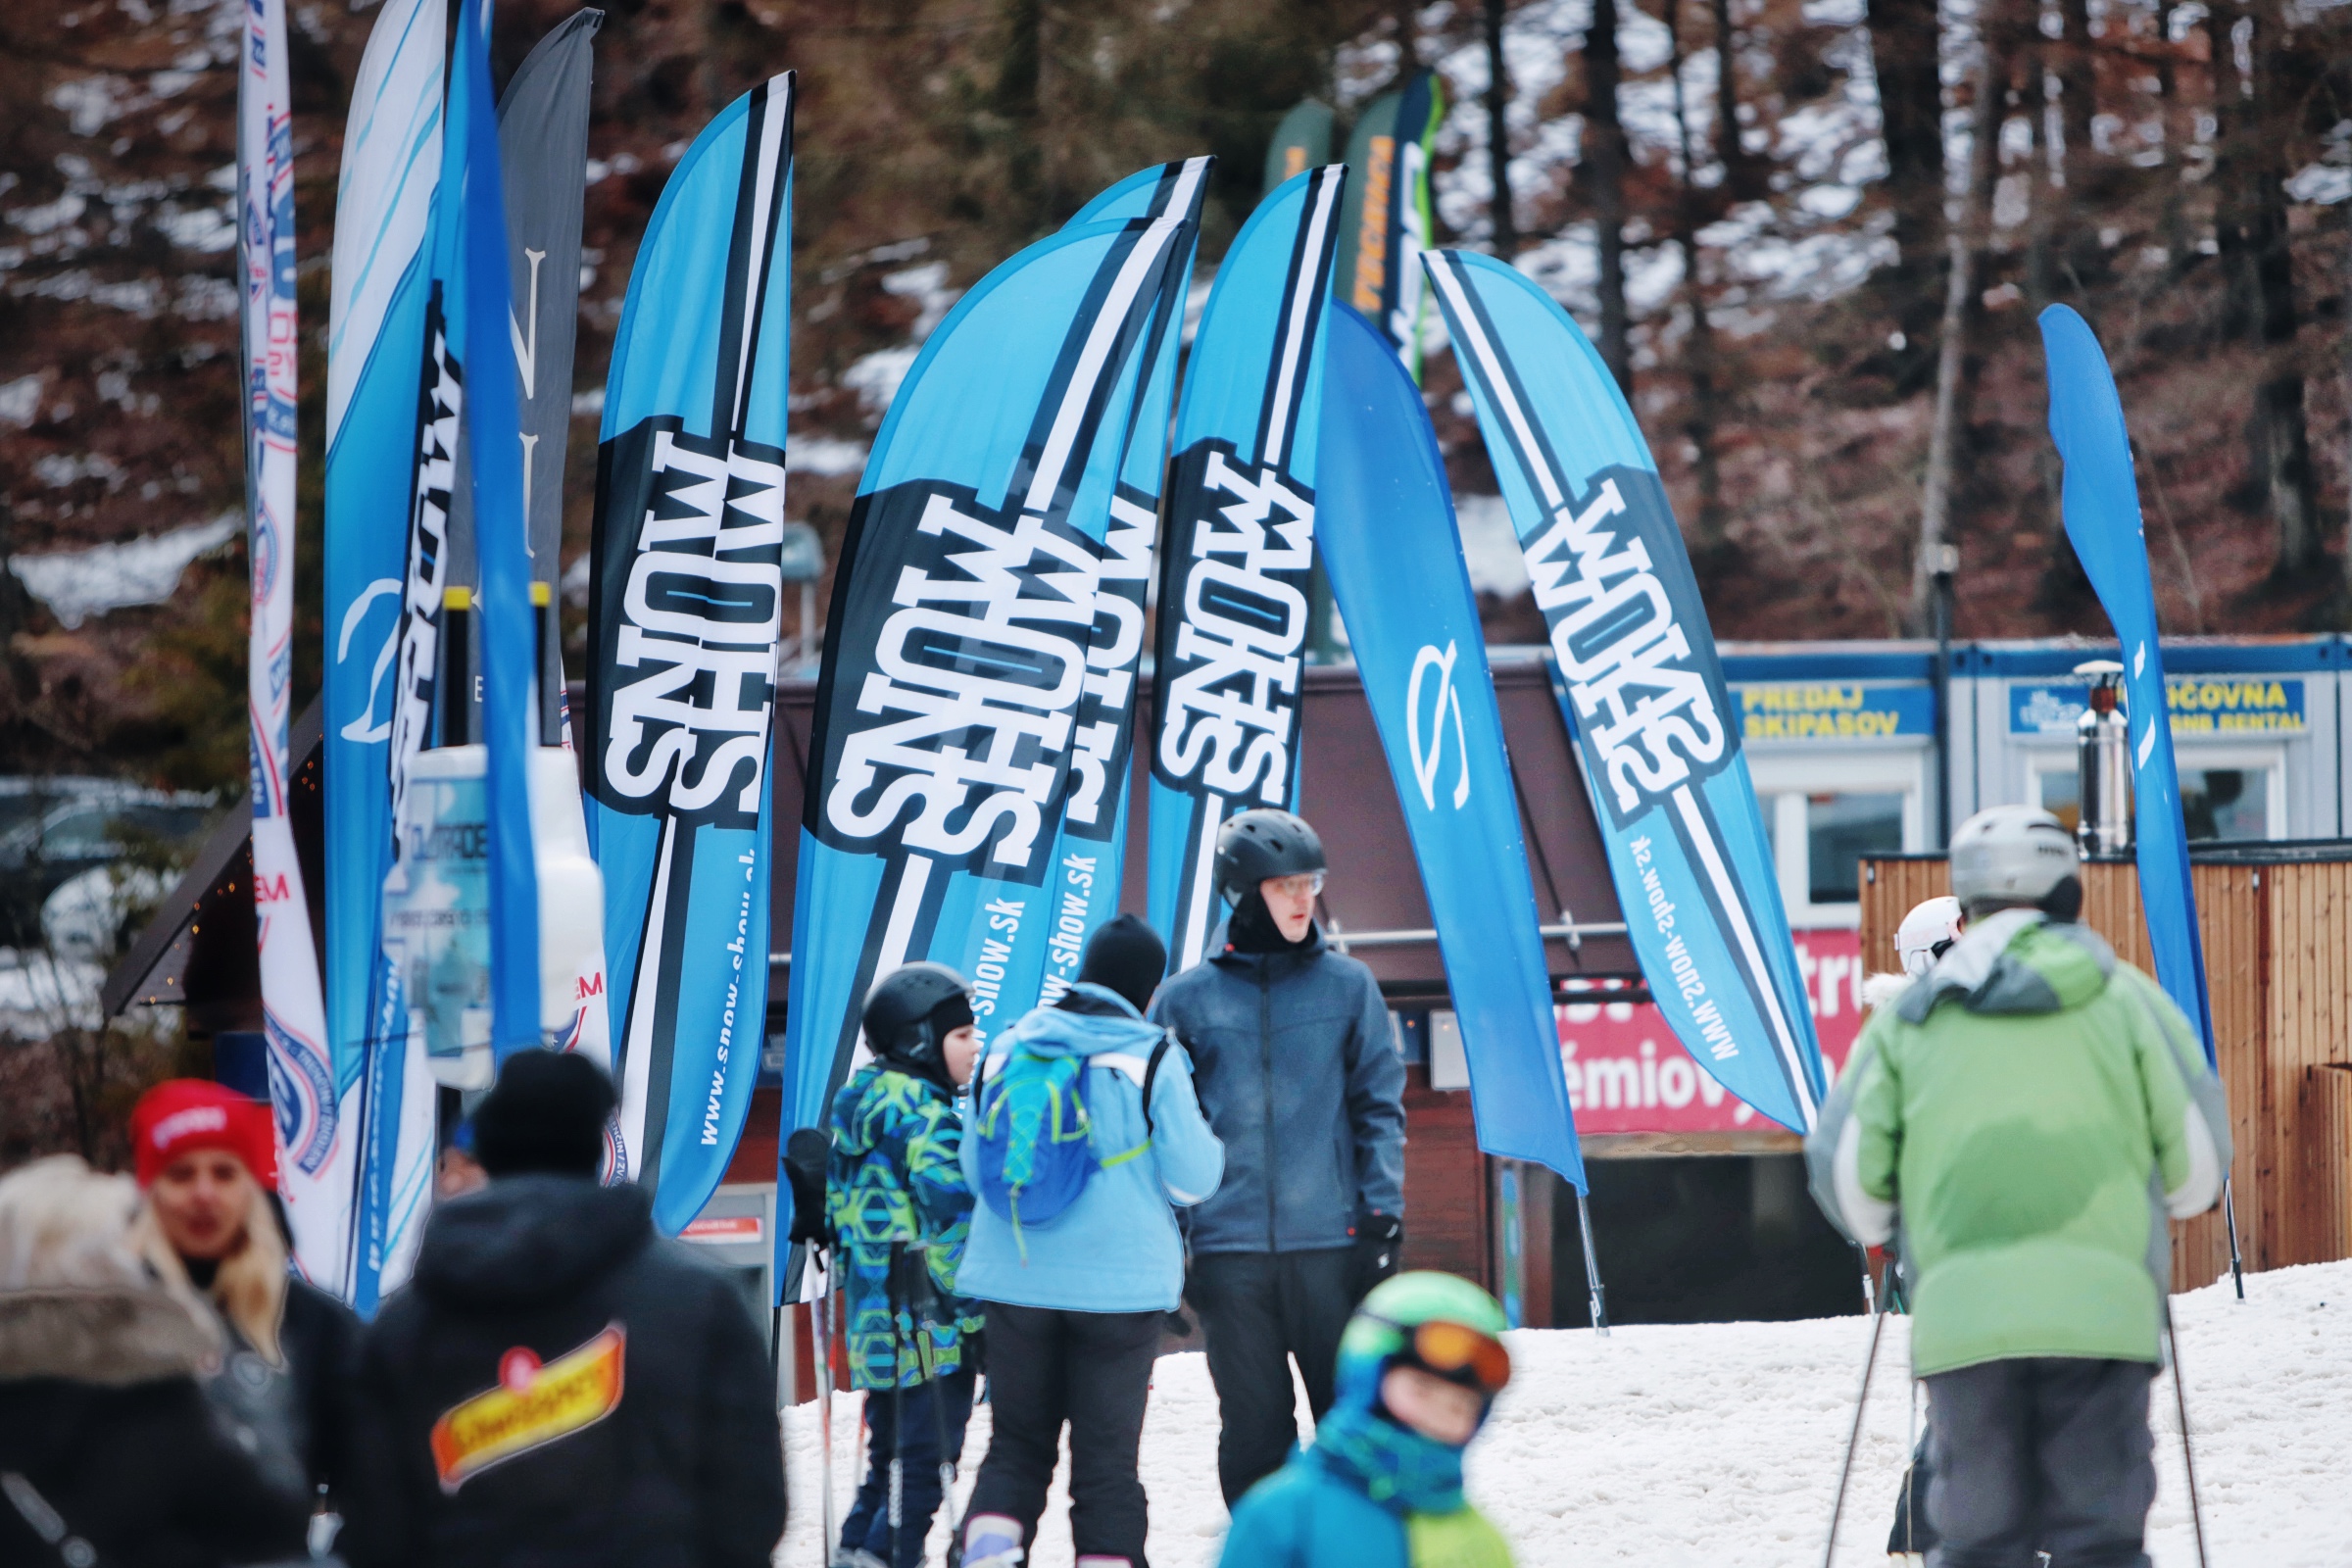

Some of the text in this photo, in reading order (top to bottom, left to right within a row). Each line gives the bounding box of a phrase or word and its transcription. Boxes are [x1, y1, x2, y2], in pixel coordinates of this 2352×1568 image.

[605, 430, 729, 798] SNOW
[668, 439, 787, 813] SHOW
[827, 493, 1019, 838] SNOW
[902, 514, 1102, 867] SHOW
[1160, 451, 1274, 777] SNOW
[1202, 468, 1314, 805] SHOW
[1742, 686, 1864, 710] PREDAJ
[1744, 711, 1899, 738] SKIPASOV
